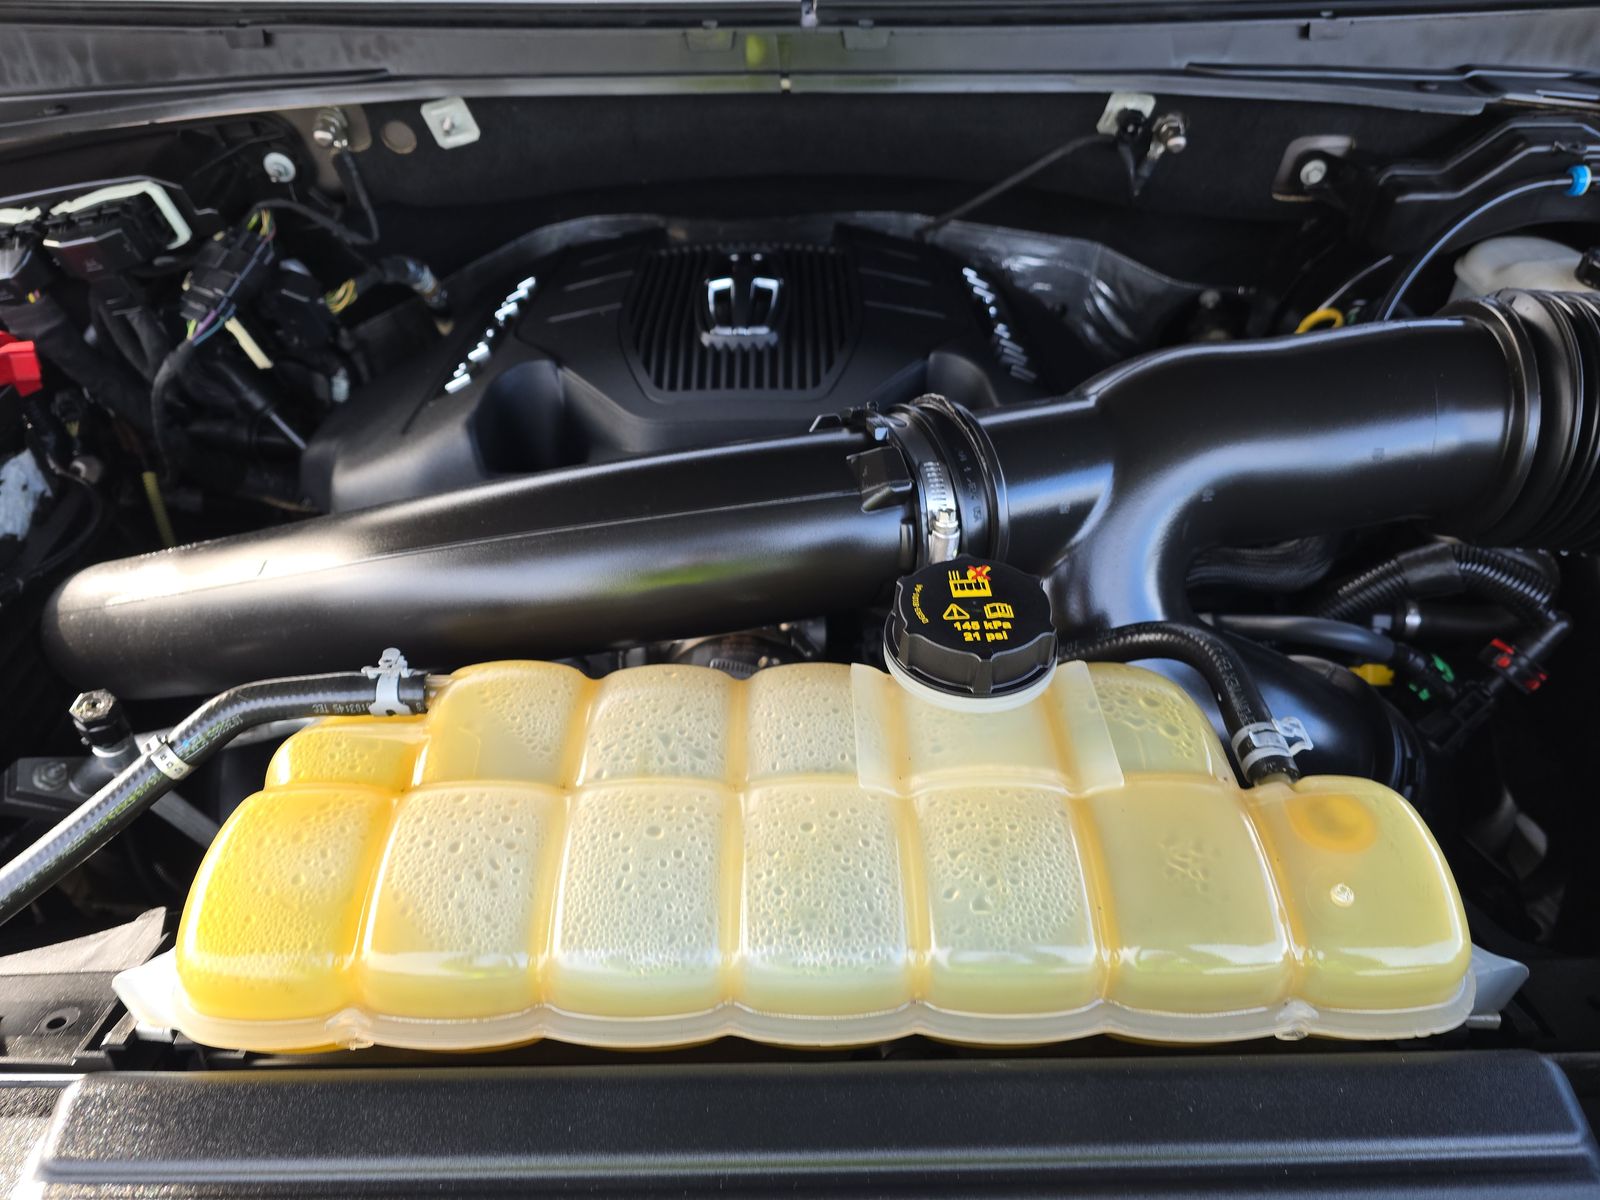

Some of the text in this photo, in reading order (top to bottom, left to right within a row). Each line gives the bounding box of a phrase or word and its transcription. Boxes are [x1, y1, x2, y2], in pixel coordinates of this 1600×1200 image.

[953, 620, 1012, 631] 145 kPa
[963, 630, 1009, 642] 21 psi
